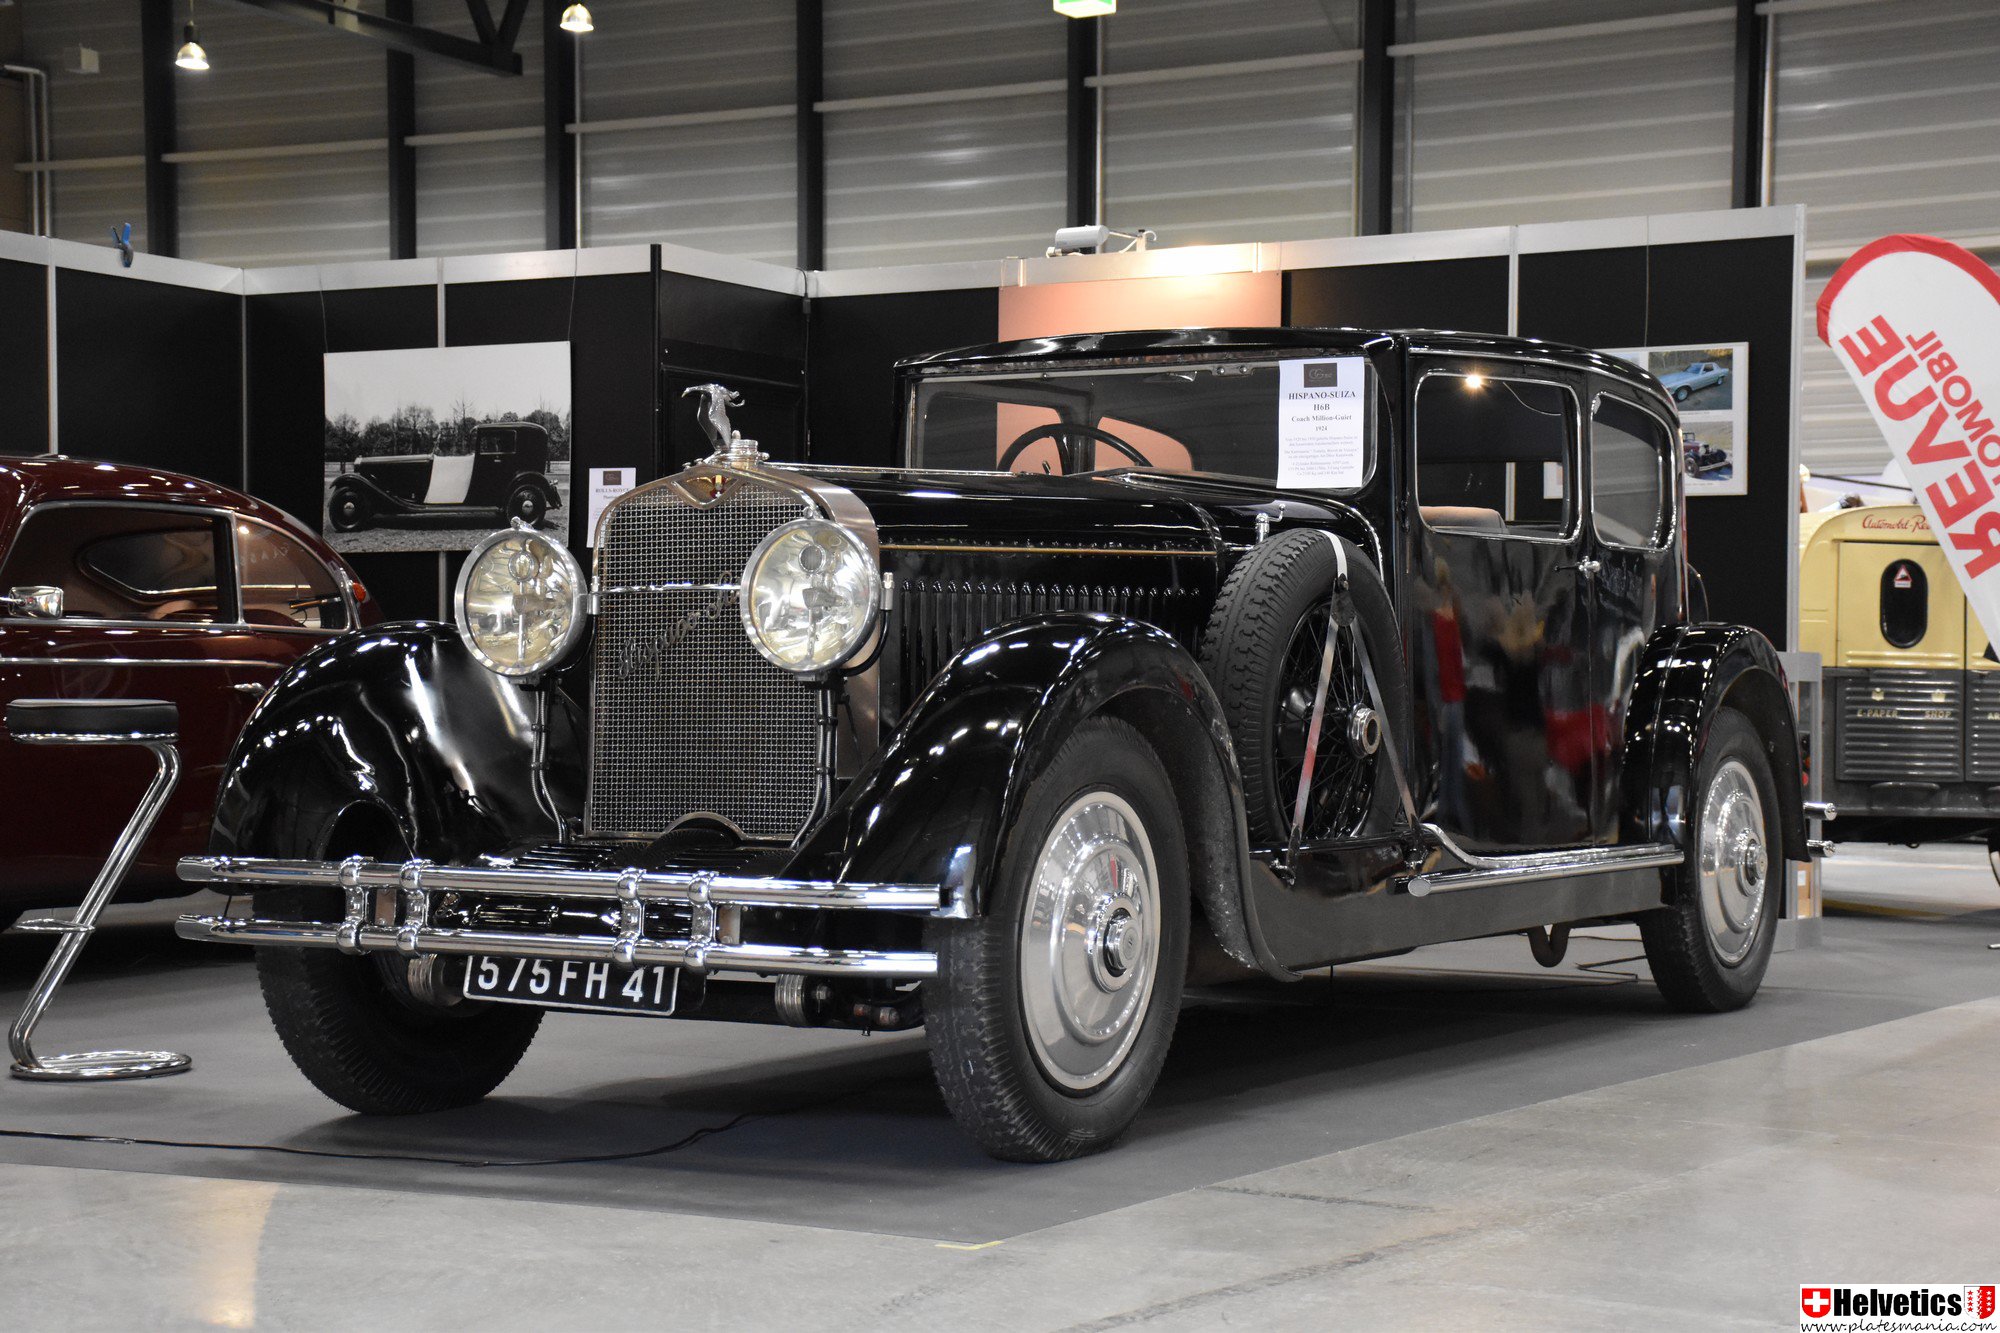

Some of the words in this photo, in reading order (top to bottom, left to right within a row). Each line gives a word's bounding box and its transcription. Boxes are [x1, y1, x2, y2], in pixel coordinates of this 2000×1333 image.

[1288, 390, 1356, 400] HISPANO-SUIZA
[1313, 403, 1330, 411] H6B
[1857, 708, 1898, 718] E-PAPER
[1924, 709, 1952, 719] SHOP
[621, 965, 665, 1005] 41
